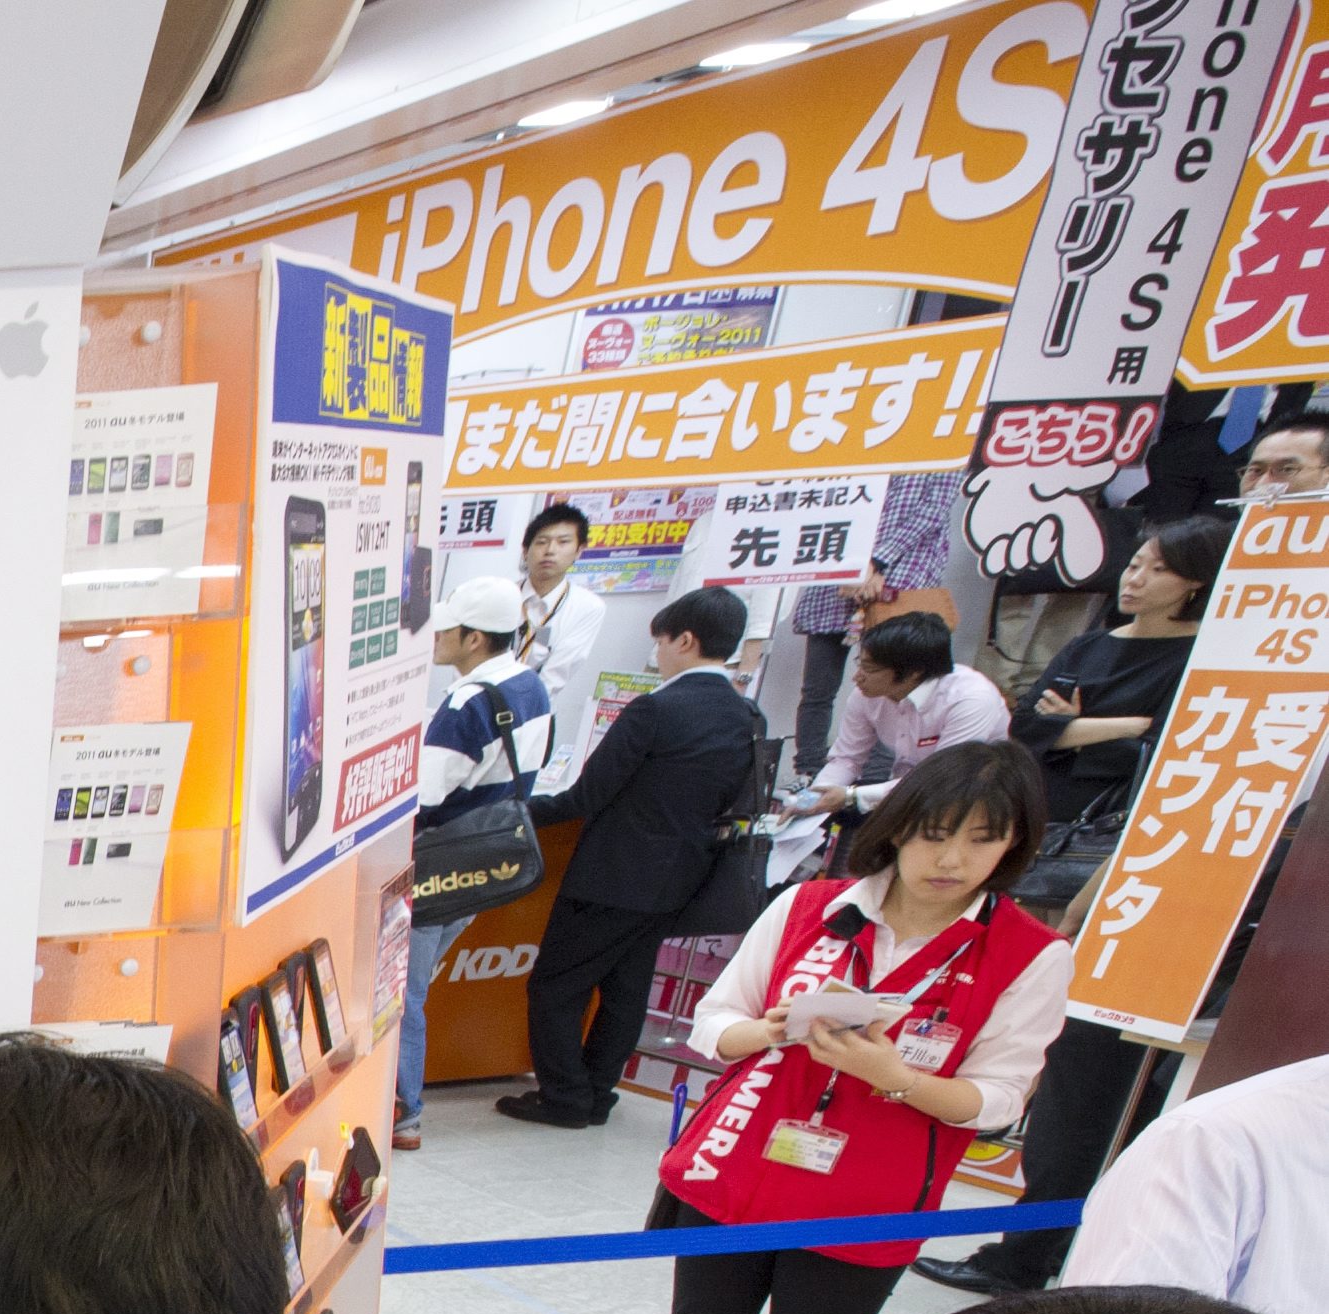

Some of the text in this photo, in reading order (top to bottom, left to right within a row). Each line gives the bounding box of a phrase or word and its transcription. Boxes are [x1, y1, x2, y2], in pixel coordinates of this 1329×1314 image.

[380, 131, 788, 315] iPhone
[820, 1, 1090, 236] 4S
[322, 291, 424, 424] 新製品情報
[85, 418, 106, 429] 2011
[110, 417, 126, 426] au
[725, 485, 873, 515] 申込書未記入
[1242, 515, 1329, 556] au
[1213, 585, 1329, 620] iPho
[1255, 629, 1318, 664] 4S
[76, 750, 95, 761] 2011
[98, 750, 112, 758] au
[1203, 690, 1329, 858] 受付
[1091, 687, 1249, 980] カウンター
[448, 944, 540, 983] KDD
[1093, 1008, 1136, 1024] ビックカメラ
[684, 1047, 785, 1182] AMERA
